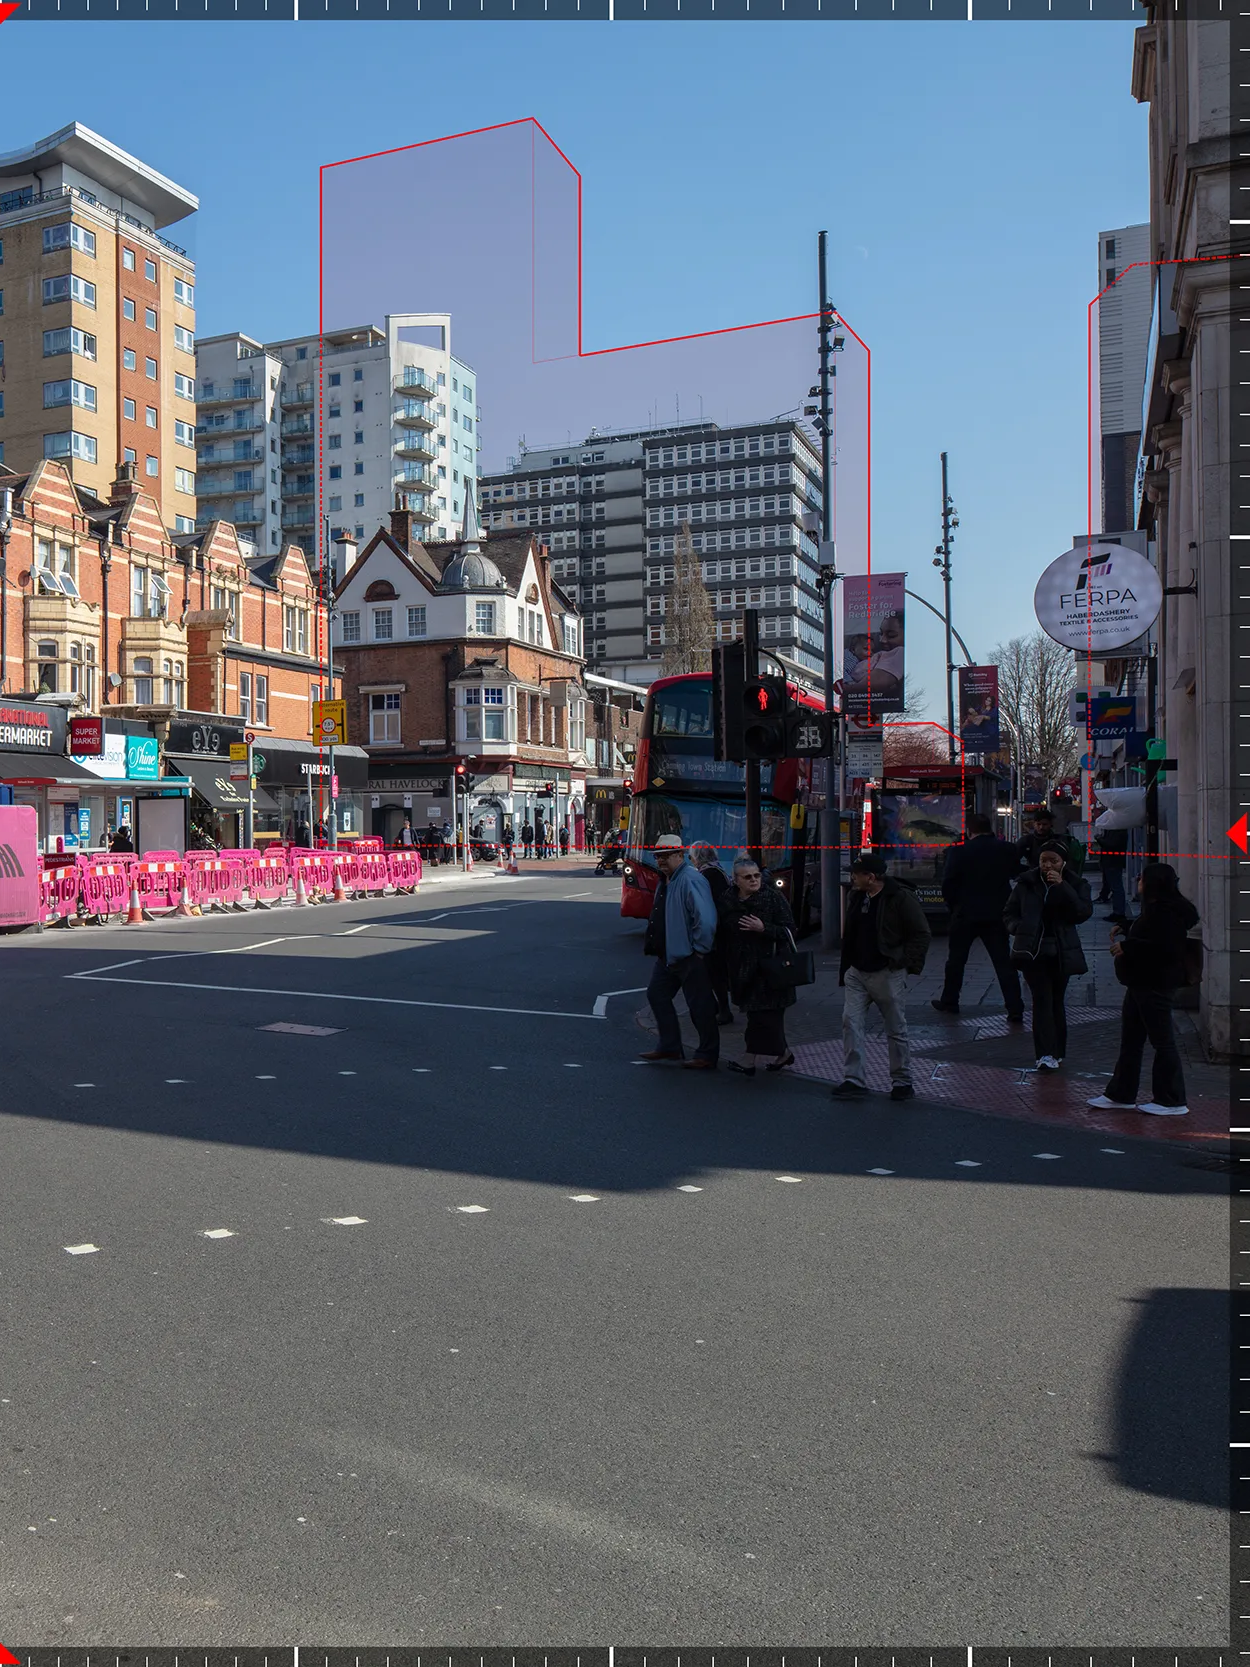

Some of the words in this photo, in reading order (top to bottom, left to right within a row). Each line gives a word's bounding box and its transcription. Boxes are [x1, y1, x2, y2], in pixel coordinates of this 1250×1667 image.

[1060, 588, 1138, 609] FERPA
[849, 602, 878, 610] Foster
[1092, 614, 1138, 623] ACCESSORIES
[75, 728, 98, 736] SUPER
[73, 737, 100, 746] MARKET
[128, 741, 156, 768] Shine
[688, 762, 702, 772] Town
[704, 764, 726, 772] Station
[390, 780, 444, 789] HAVELOCK
